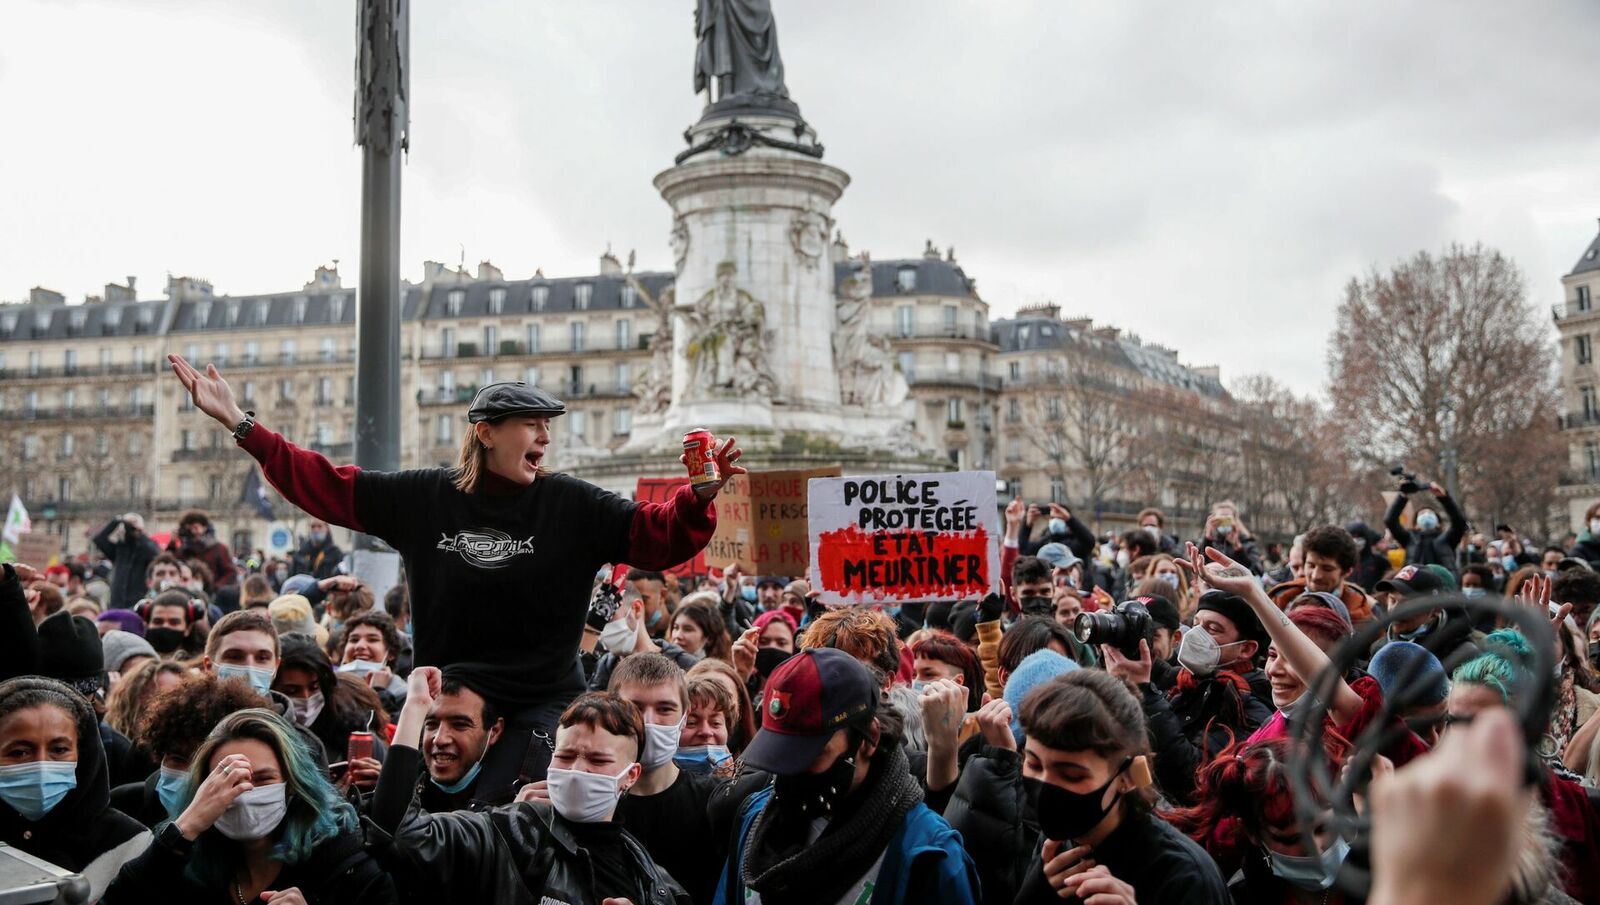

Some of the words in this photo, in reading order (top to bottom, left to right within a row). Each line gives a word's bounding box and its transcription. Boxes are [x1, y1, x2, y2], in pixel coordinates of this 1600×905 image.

[736, 475, 801, 498] MUSIQUE
[844, 475, 940, 506] POLICE
[859, 499, 978, 531] PROTÉGÉE
[780, 542, 809, 564] PR
[843, 548, 985, 588] MEURTRIER
